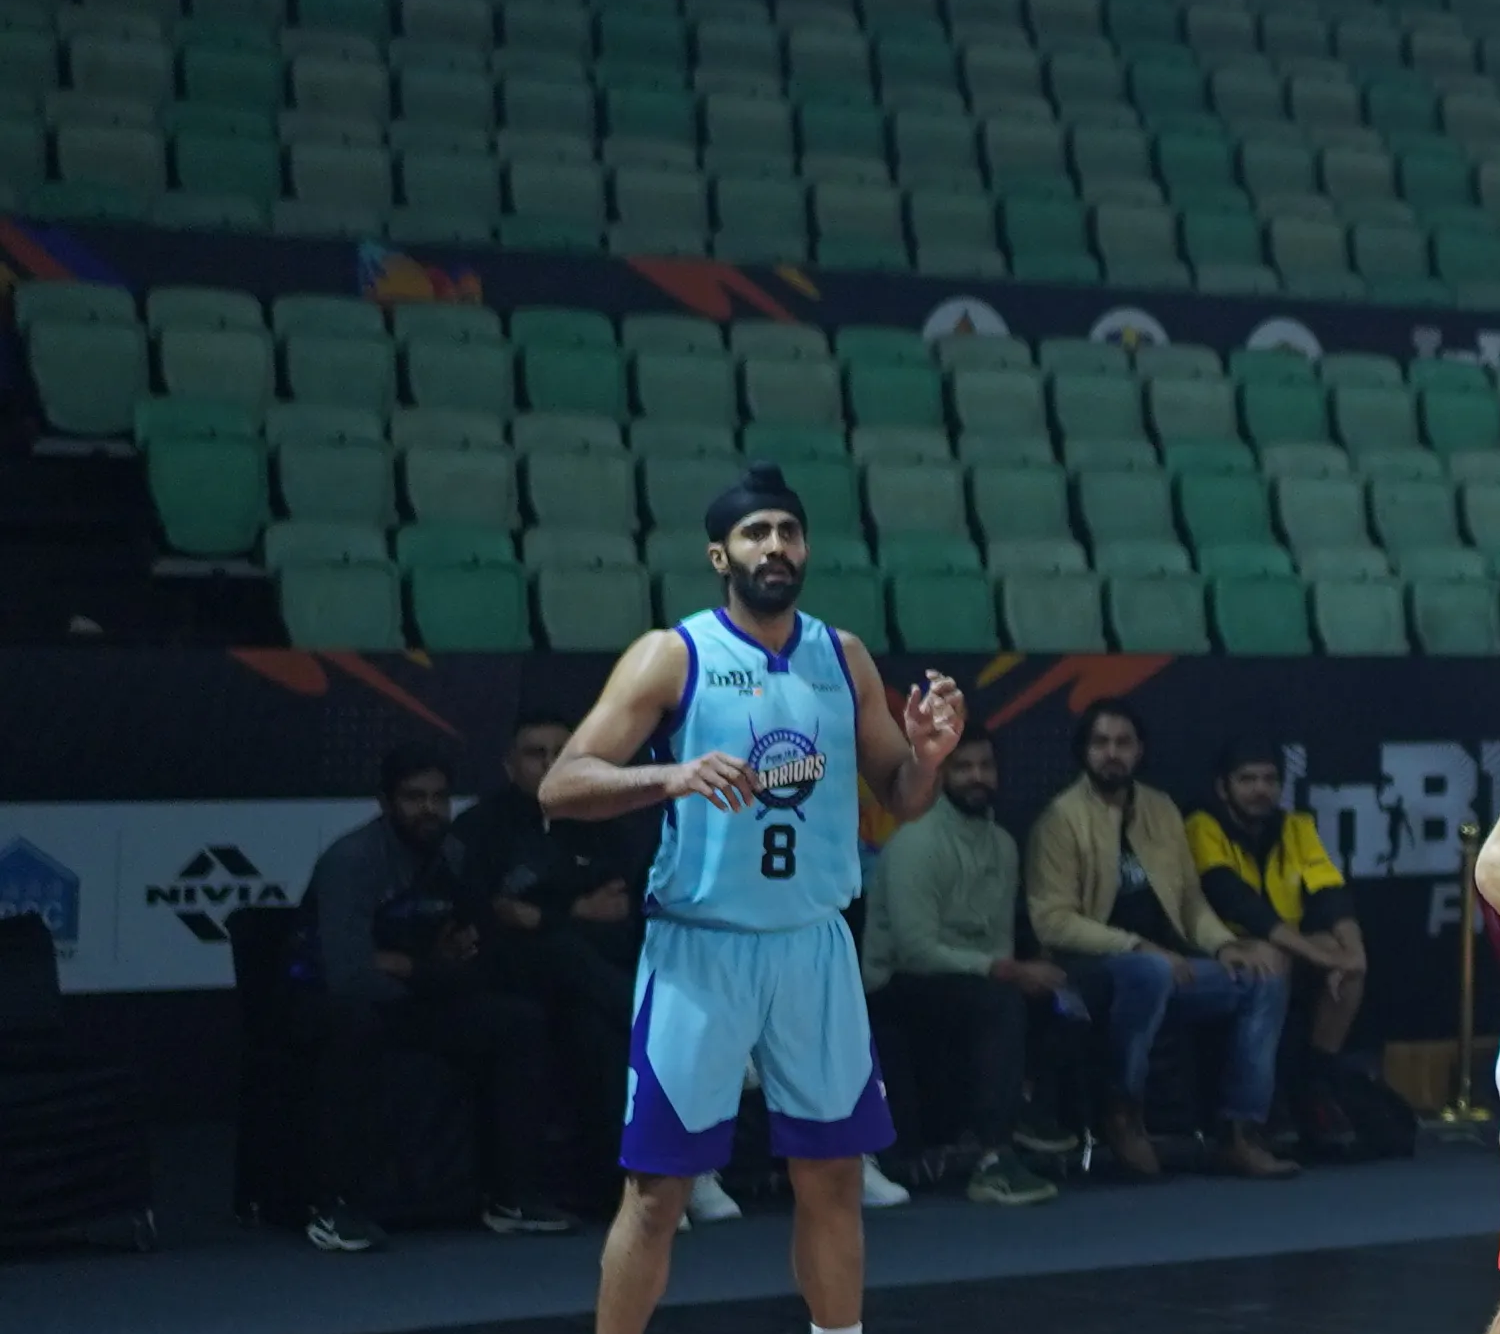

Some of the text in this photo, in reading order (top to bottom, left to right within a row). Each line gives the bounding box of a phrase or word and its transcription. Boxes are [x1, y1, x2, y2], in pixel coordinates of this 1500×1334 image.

[757, 754, 826, 790] ARRIORS
[761, 824, 796, 880] 8
[146, 883, 290, 907] NIVIA
